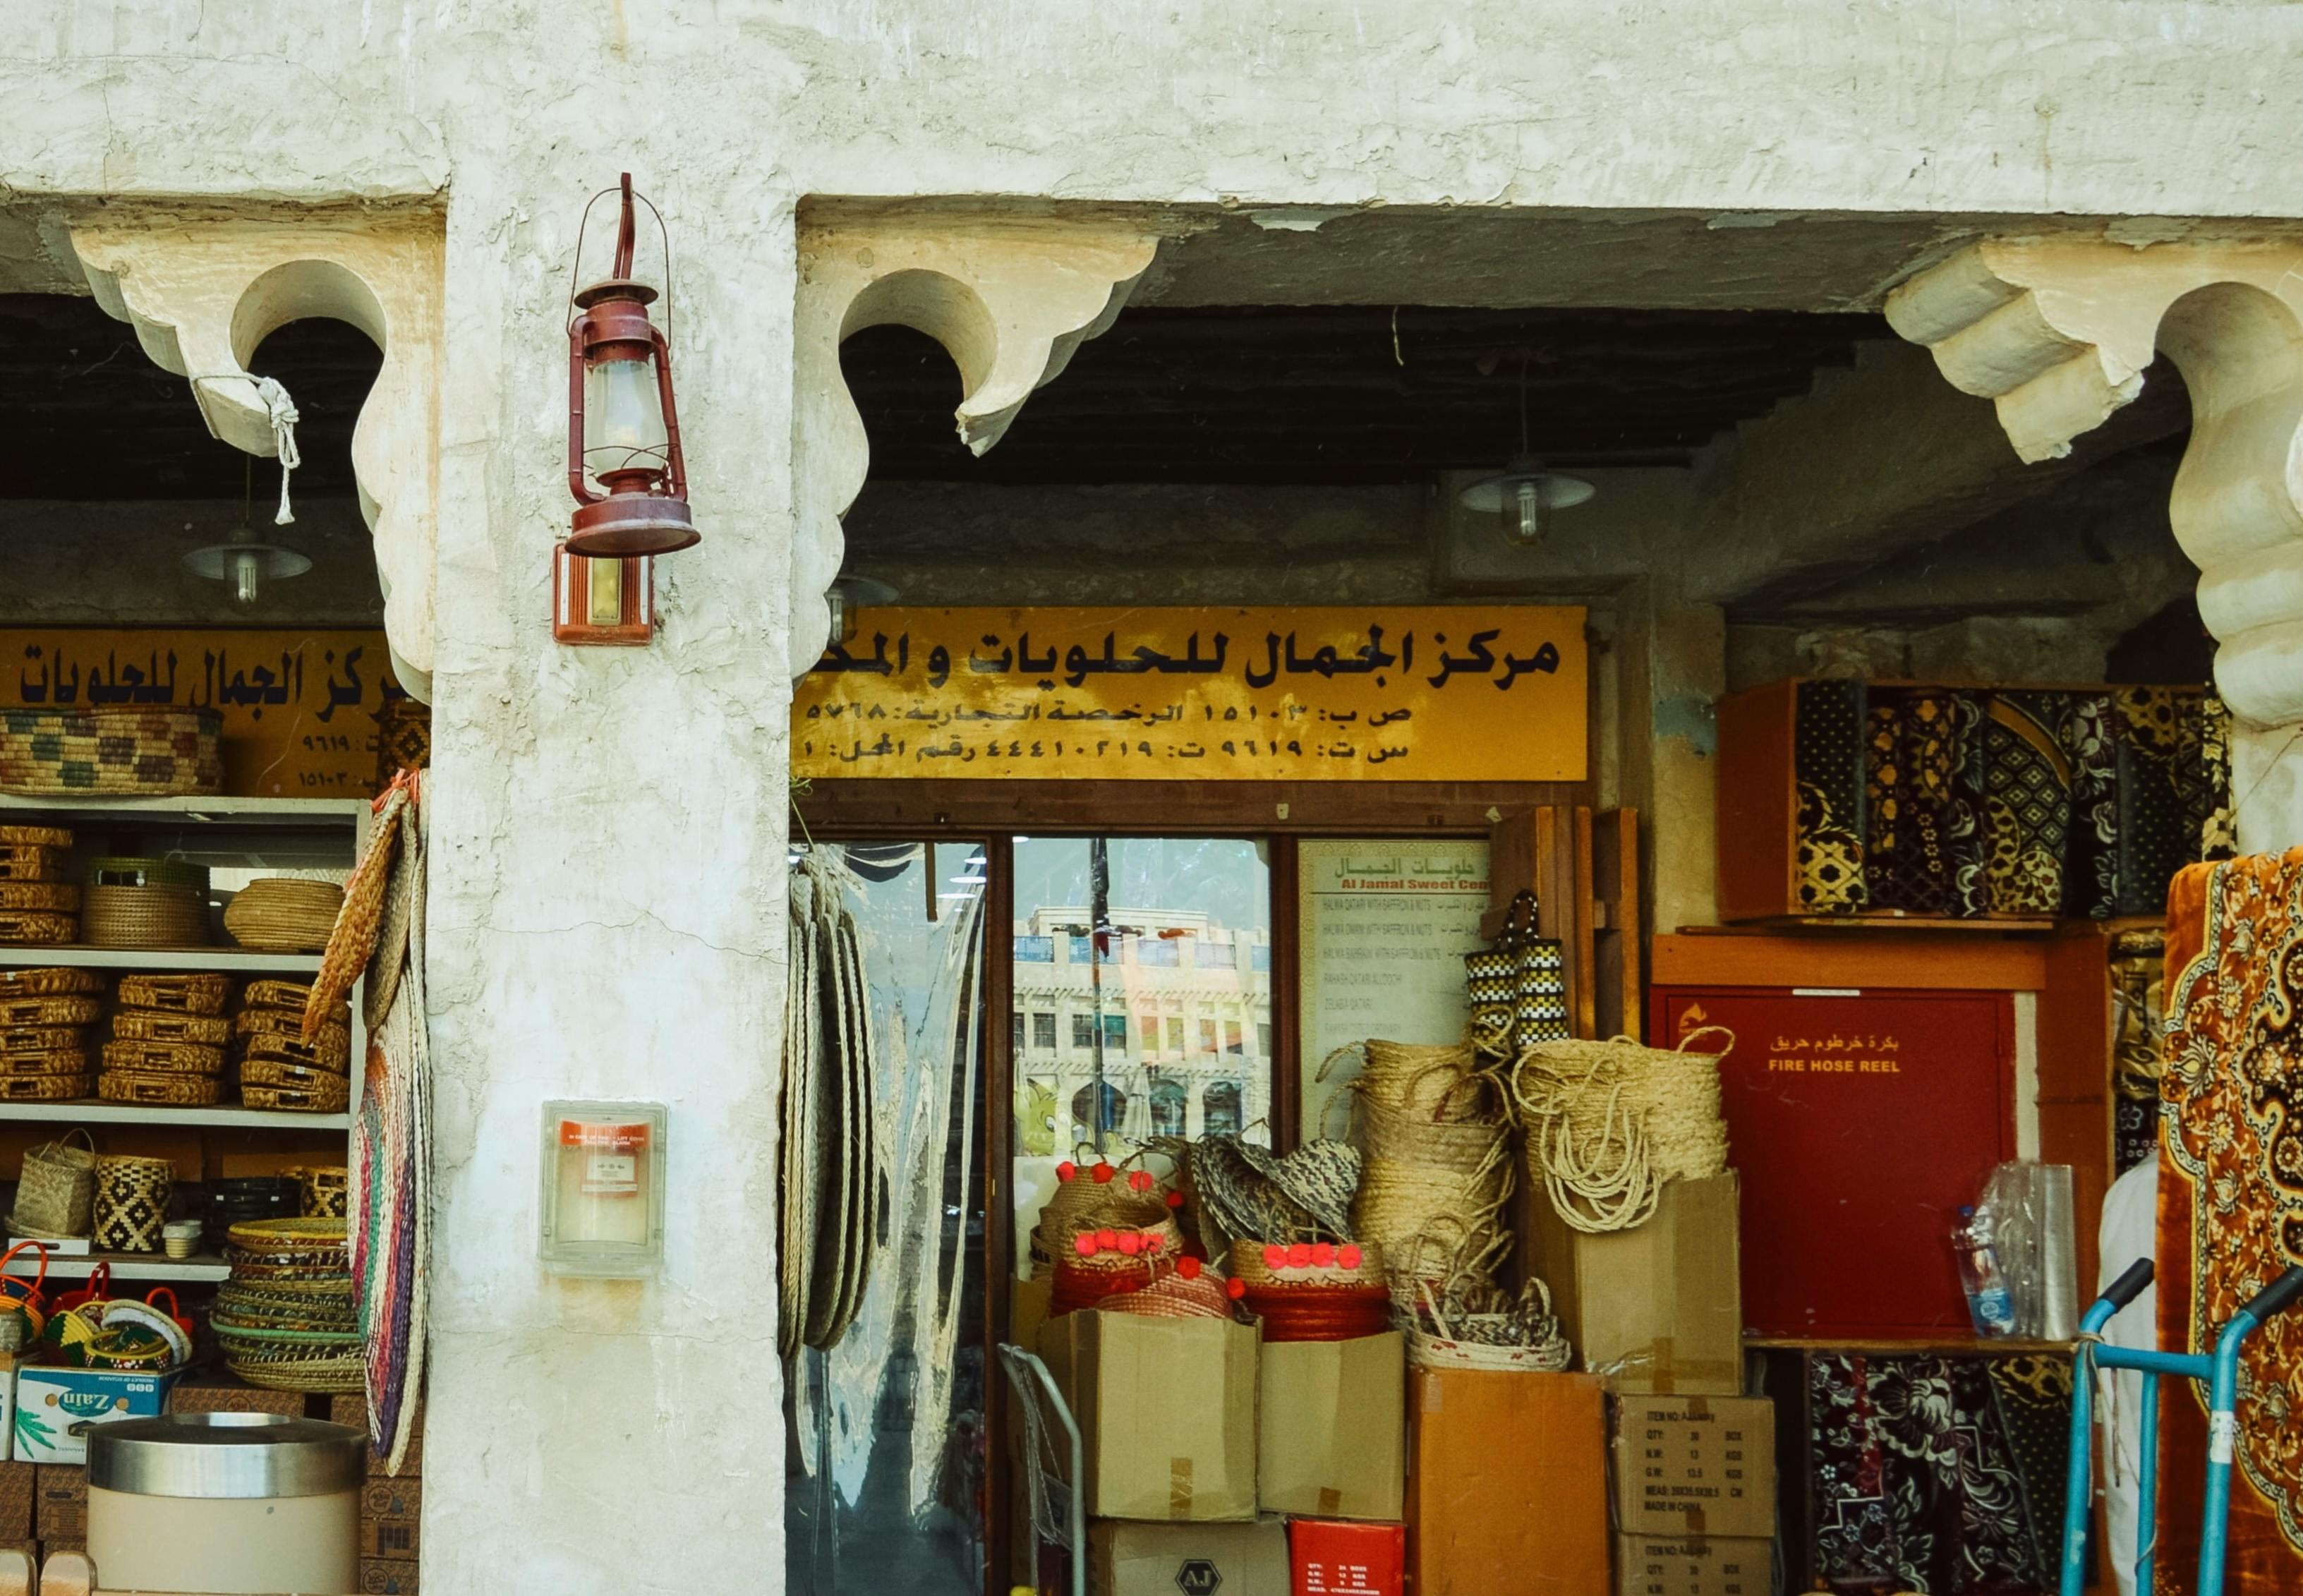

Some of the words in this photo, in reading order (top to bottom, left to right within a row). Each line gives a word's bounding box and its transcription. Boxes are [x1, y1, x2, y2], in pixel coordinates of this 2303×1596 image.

[969, 630, 1229, 692] للحلويات
[1245, 623, 1413, 689] الجمال
[1427, 629, 1560, 691] مركز
[315, 646, 407, 723] ركز
[1046, 699, 1183, 727] الرخصة
[917, 734, 976, 763] رقم
[1341, 879, 1356, 890] Al
[1360, 879, 1404, 890] Jamal
[1408, 879, 1455, 890] Sweet
[1458, 879, 1489, 890] Cen
[1770, 1035, 1810, 1052] حريق
[1814, 1034, 1863, 1053] خرطوم
[1868, 1034, 1899, 1052] بكرة
[1768, 1059, 1805, 1071] FIRE
[1810, 1060, 1854, 1072] HOSE
[1859, 1060, 1901, 1072] REEL
[64, 1393, 109, 1410] Zain
[1644, 1501, 1666, 1511] MADE
[1184, 1570, 1212, 1587] AJ
